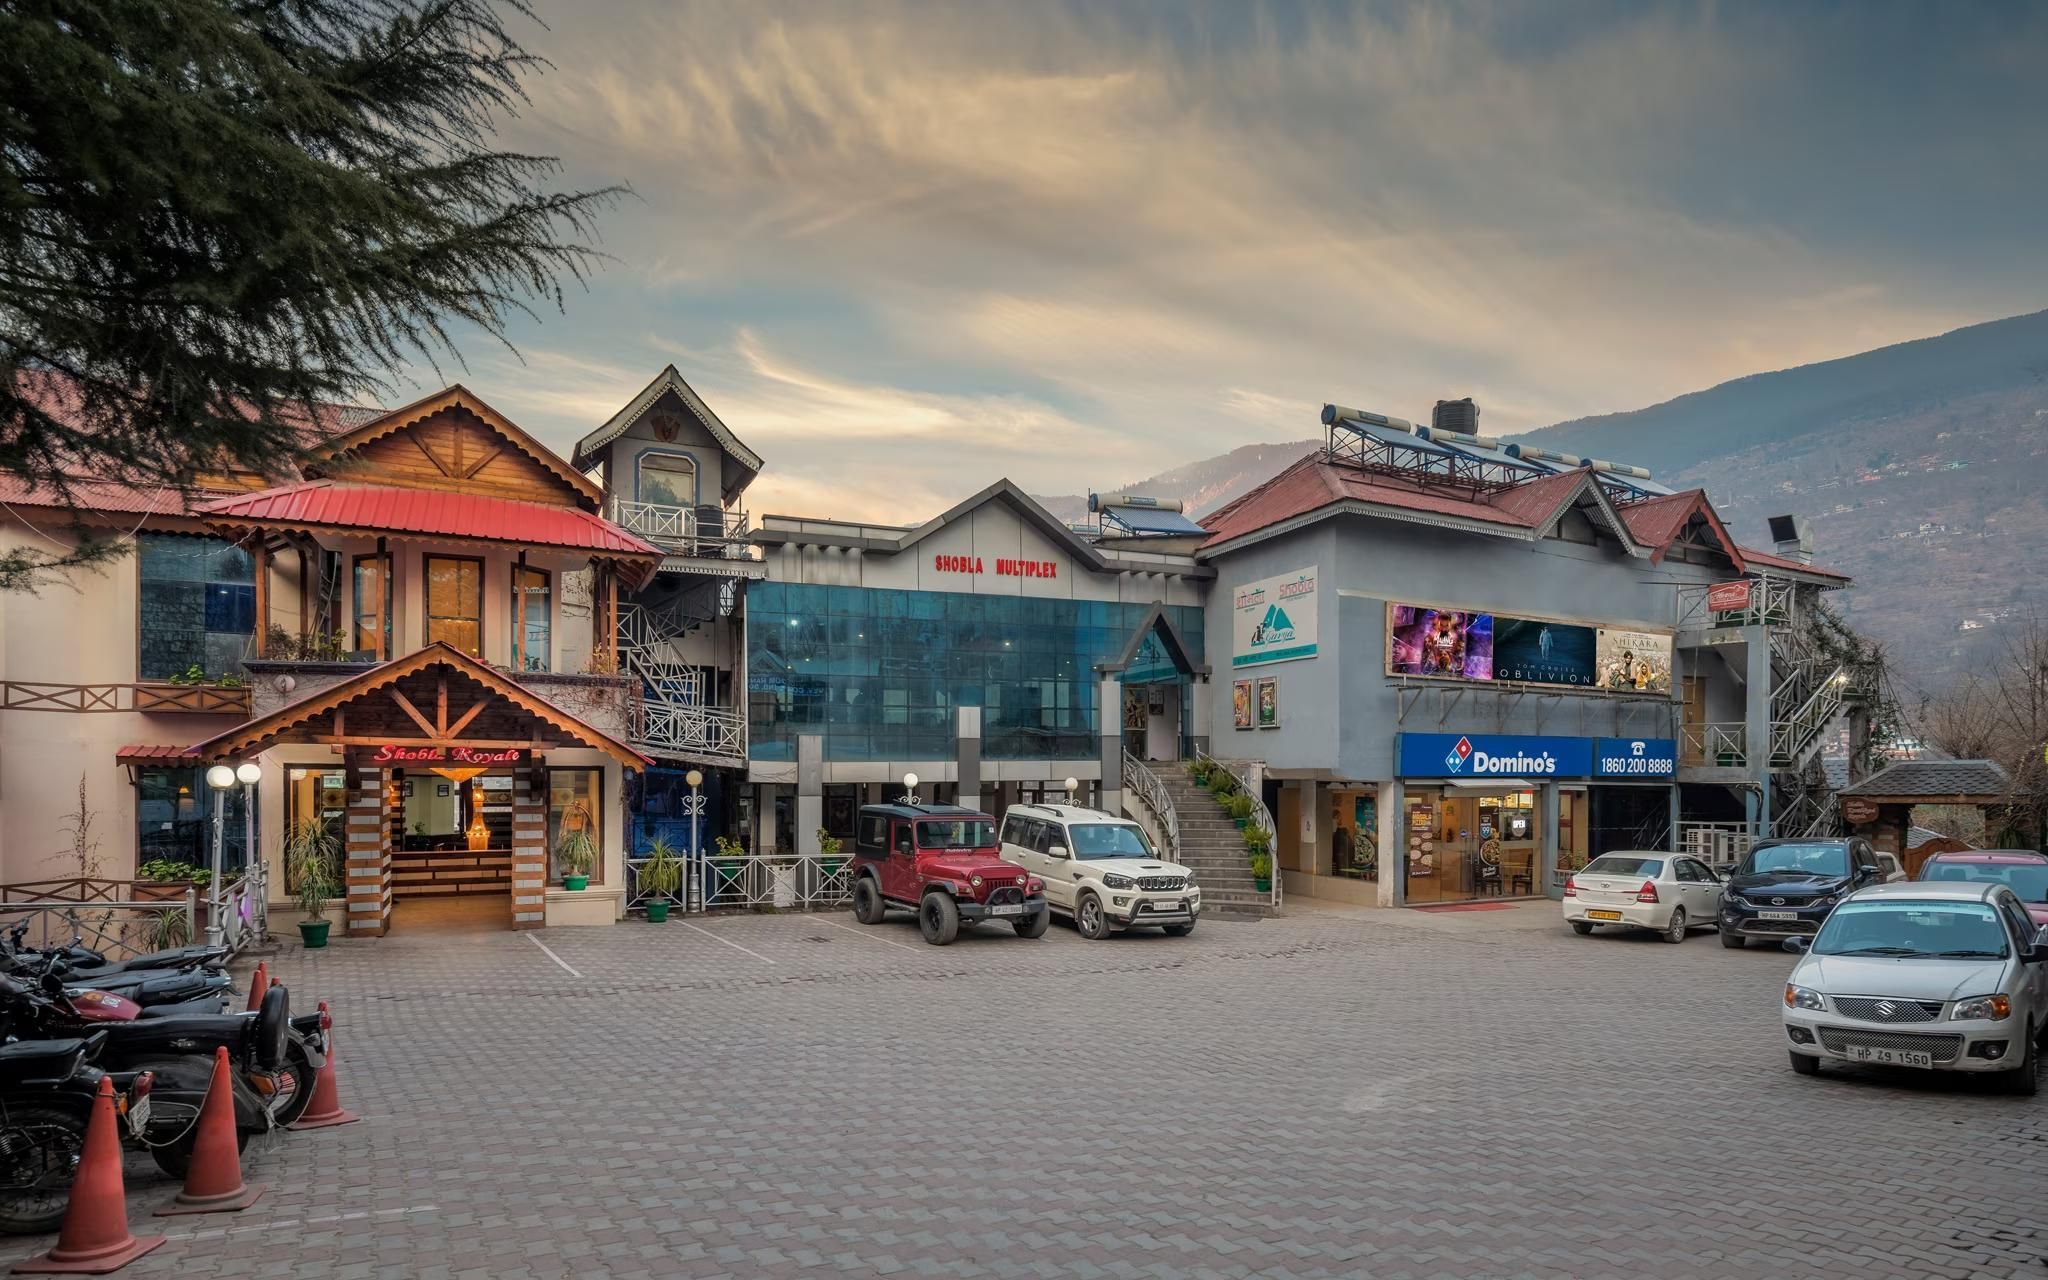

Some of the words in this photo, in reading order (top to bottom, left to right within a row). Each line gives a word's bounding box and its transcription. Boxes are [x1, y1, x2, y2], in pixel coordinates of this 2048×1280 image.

[935, 555, 983, 574] SHOBLA
[996, 558, 1057, 578] MULTIPLEX
[1613, 637, 1659, 649] SHIKARA
[1500, 669, 1590, 683] OBLIVION
[1541, 665, 1575, 673] CRUISE
[452, 745, 520, 763] Royale
[1473, 751, 1556, 773] Domino's
[1601, 757, 1625, 773] 1860
[1627, 758, 1646, 773] 200
[1648, 758, 1673, 774] 8888
[1857, 1049, 1871, 1060] HP
[1898, 1053, 1928, 1065] 1560
